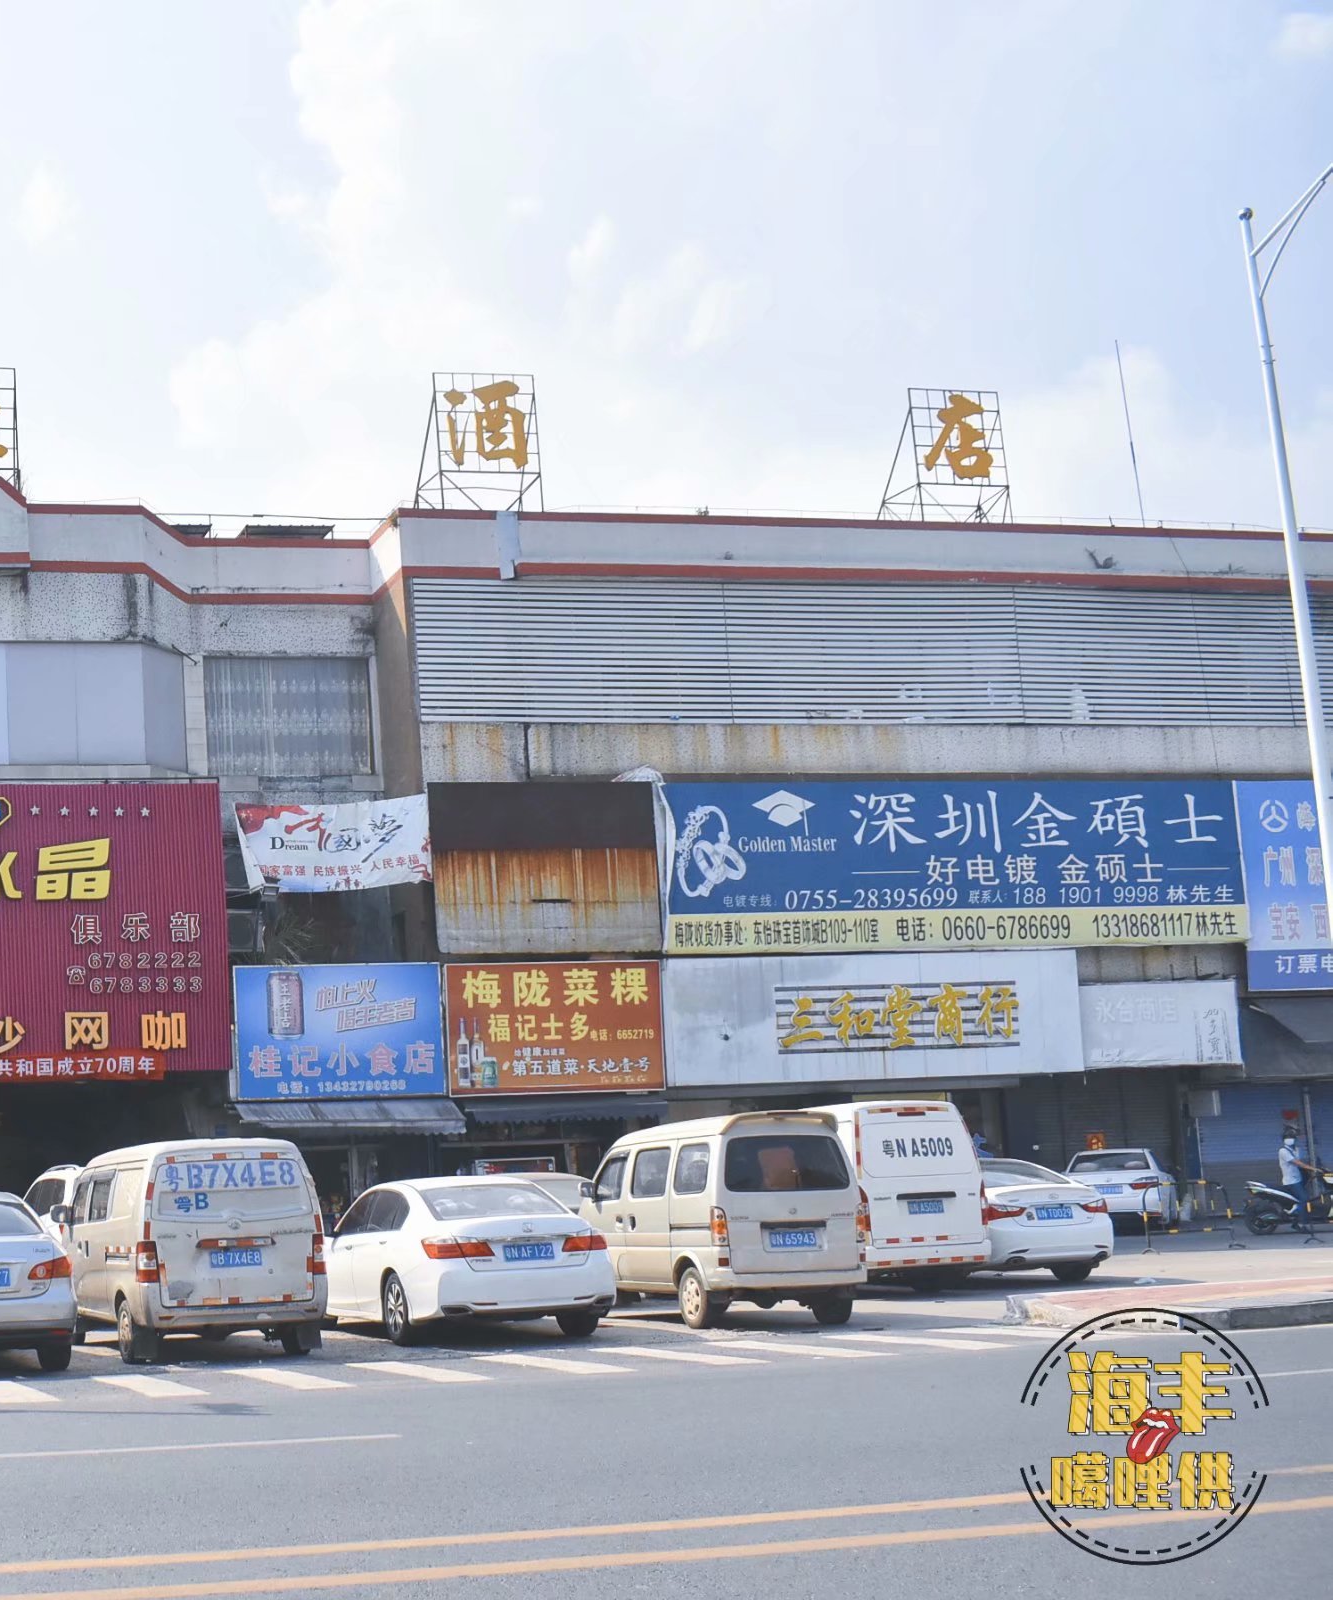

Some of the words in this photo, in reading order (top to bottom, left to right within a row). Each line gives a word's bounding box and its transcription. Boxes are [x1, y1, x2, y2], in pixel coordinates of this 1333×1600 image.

[270, 836, 308, 851] Dream
[738, 836, 786, 852] Golden
[790, 836, 837, 852] Master
[313, 863, 362, 877] 民族振兴
[370, 854, 419, 873] 人民幸福
[926, 854, 1039, 887] 好电镀
[1057, 853, 1164, 885] 金硕士
[723, 894, 778, 909] 电镀专线：
[784, 888, 958, 910] 0755-28395699
[969, 890, 1007, 904] 联系人：
[1013, 887, 1046, 905] 188
[1059, 886, 1101, 905] 1901
[1113, 886, 1159, 904] 9998
[1166, 884, 1234, 904] 林先生
[70, 912, 201, 944] 俱乐部
[896, 916, 934, 942] 电话：
[942, 914, 1071, 942] 0660-6786699
[88, 951, 202, 969] 6782222
[89, 976, 203, 994] 6783333
[462, 967, 649, 1009] 梅陇菜粿
[488, 1012, 590, 1043] 福记士多
[590, 1029, 612, 1041] 电话：
[616, 1028, 655, 1040] 6652719
[777, 983, 1019, 1049] 三和堂商行
[248, 1041, 435, 1079] 桂记小食店
[882, 1138, 908, 1159] 粤N
[911, 1136, 954, 1157] A5009
[162, 1160, 296, 1193] 粤B7X4E8
[174, 1192, 210, 1213] 粤B
